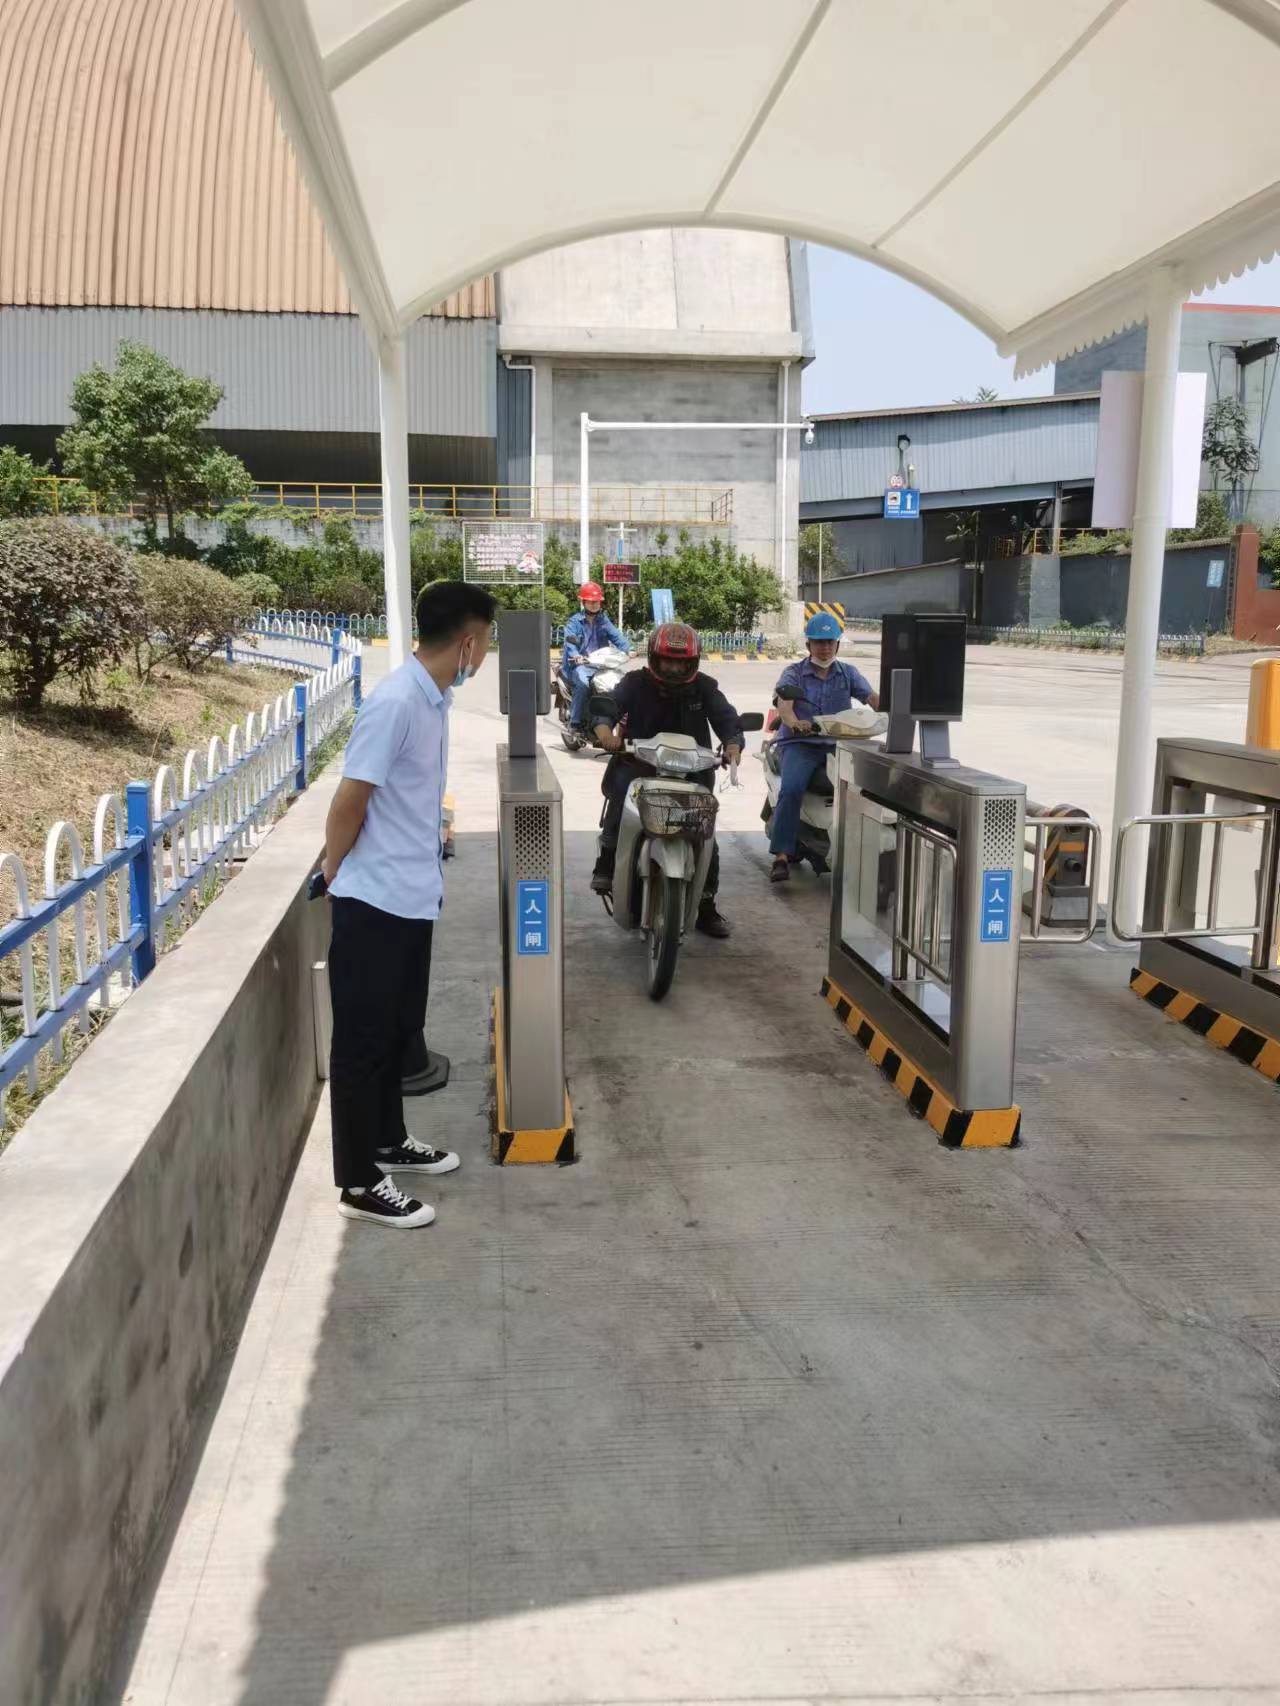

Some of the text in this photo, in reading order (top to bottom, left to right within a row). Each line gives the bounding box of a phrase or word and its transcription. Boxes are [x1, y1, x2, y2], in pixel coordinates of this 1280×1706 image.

[524, 887, 542, 947] 一人一闸
[988, 877, 1006, 935] 一人一闸
